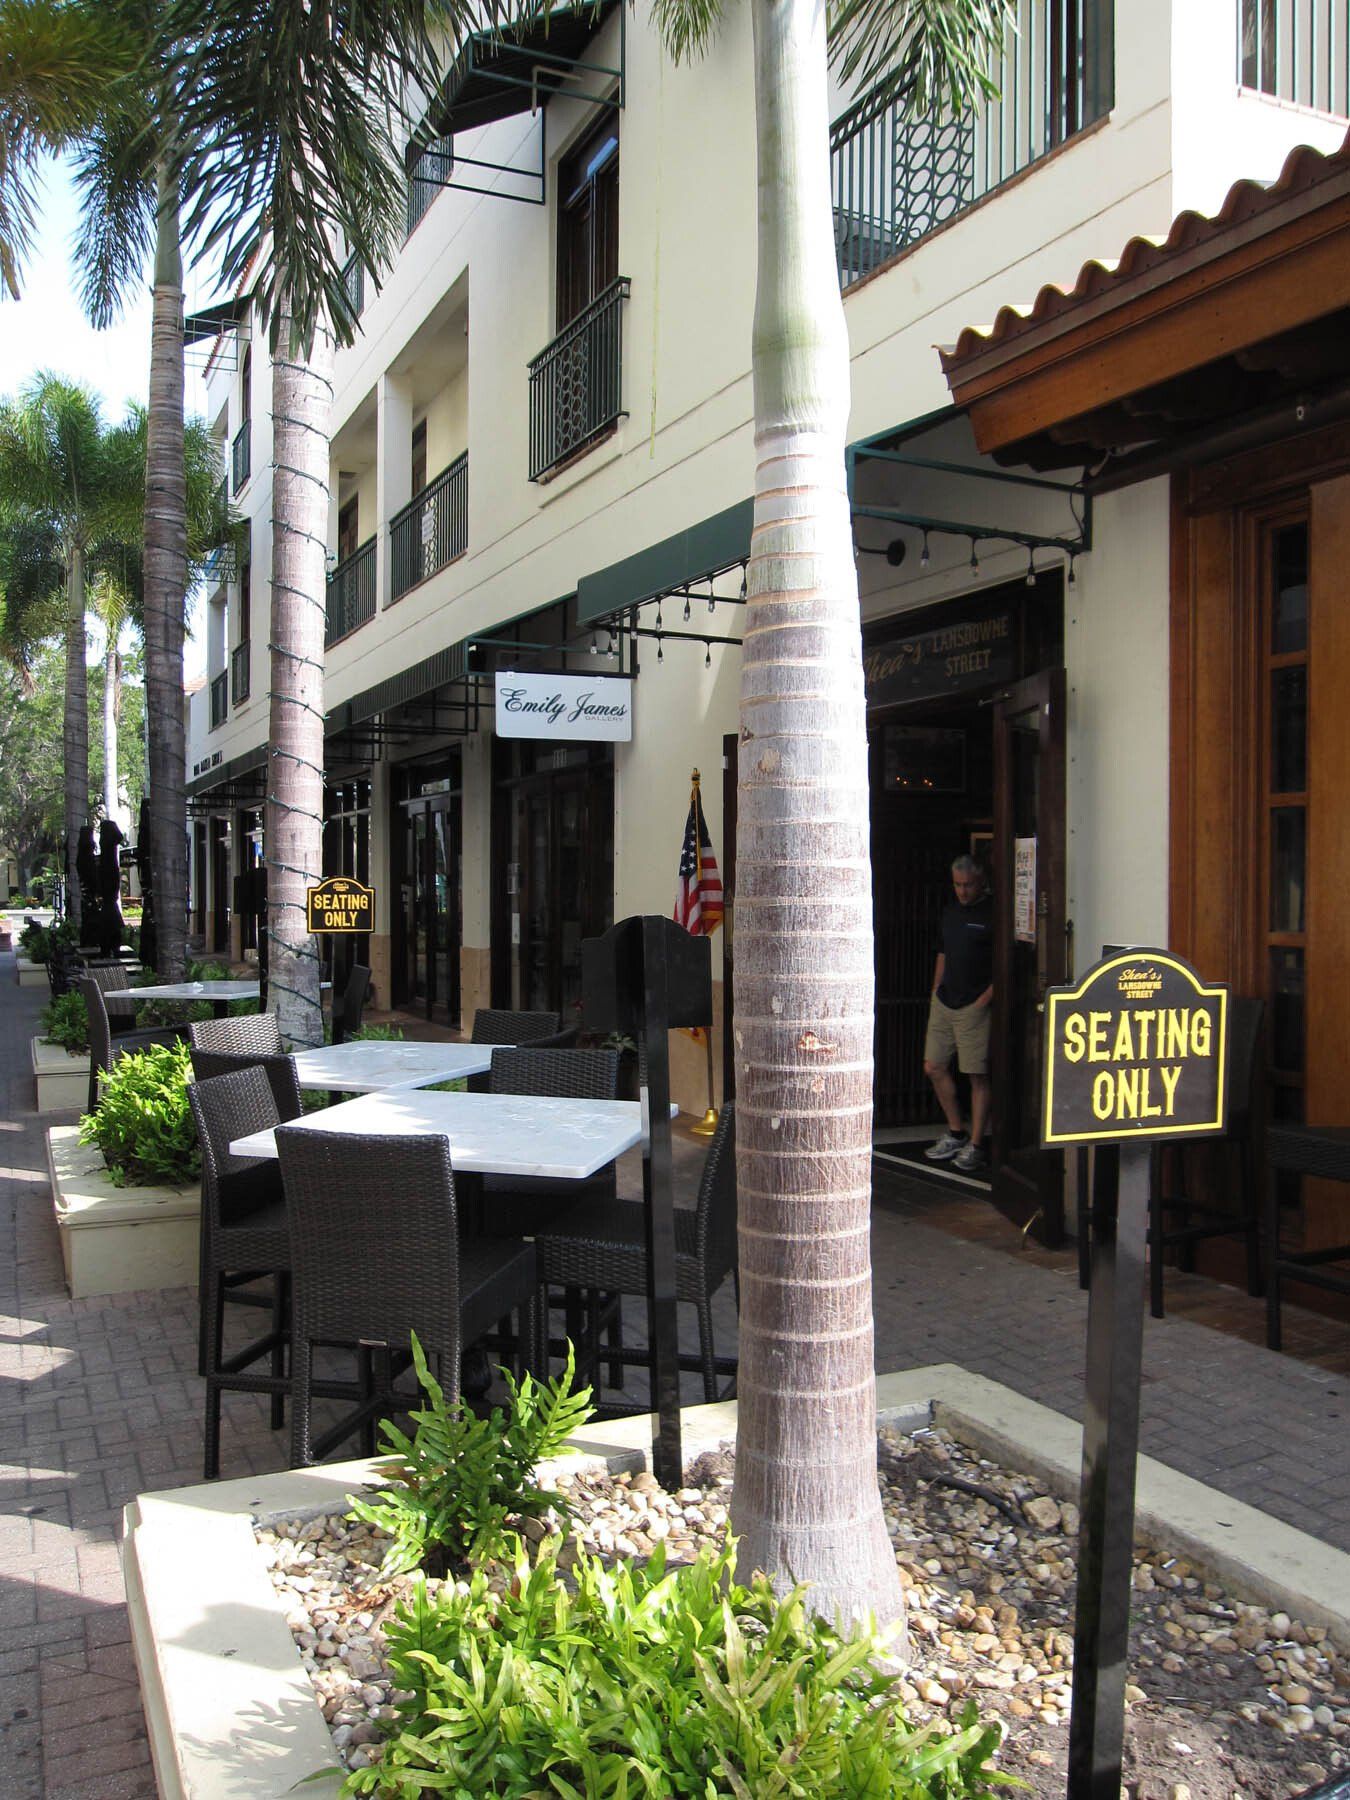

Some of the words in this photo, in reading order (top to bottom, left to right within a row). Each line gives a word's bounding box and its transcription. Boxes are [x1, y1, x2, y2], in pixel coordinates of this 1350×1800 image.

[931, 616, 1009, 654] LANSDOWNE
[944, 650, 992, 678] STREET
[500, 687, 567, 724] Emily
[567, 692, 628, 723] James
[314, 894, 369, 910] SEATING
[325, 911, 358, 927] ONLY
[1118, 981, 1162, 990] LANSDOWNE
[1126, 990, 1154, 999] STREET
[1064, 1008, 1212, 1063] SEATING
[1092, 1066, 1183, 1120] ONLY
